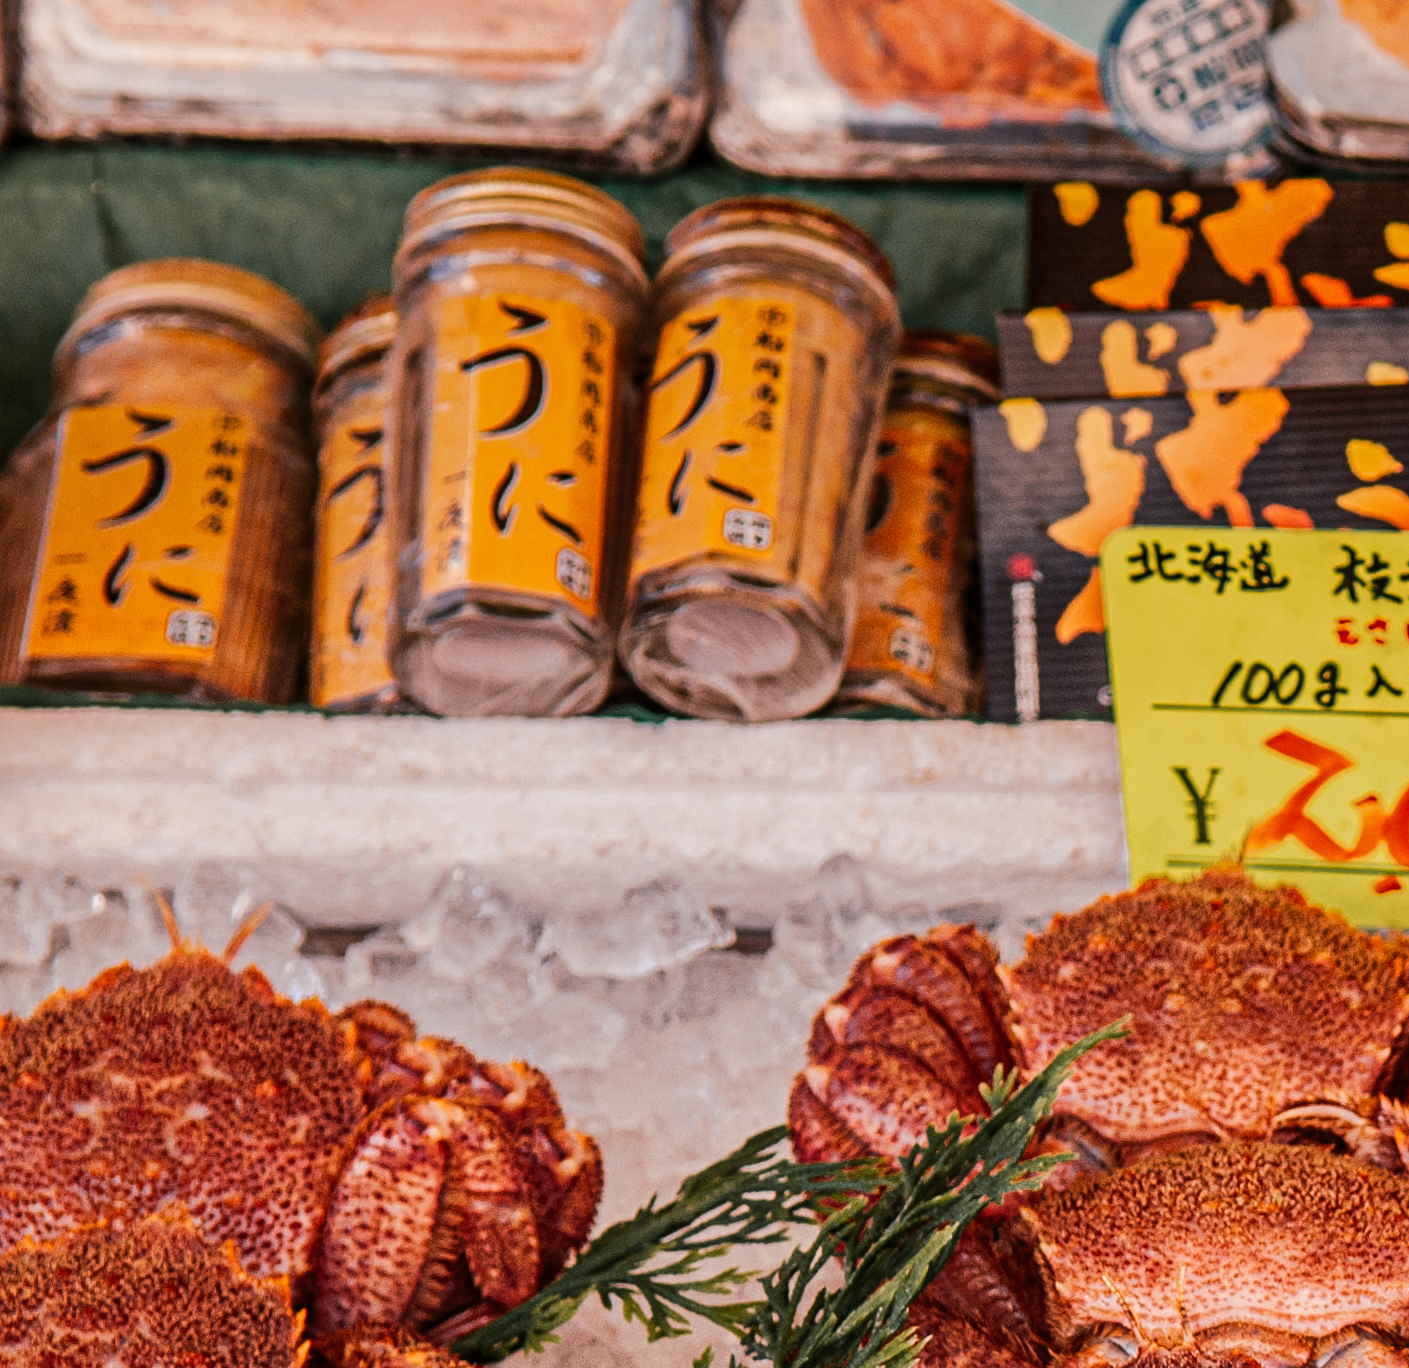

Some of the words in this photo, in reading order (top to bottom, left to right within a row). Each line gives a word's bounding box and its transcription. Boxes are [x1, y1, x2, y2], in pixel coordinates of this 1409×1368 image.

[81, 406, 202, 606] うに
[462, 301, 585, 545] うに
[648, 314, 757, 516] うに
[1127, 540, 1290, 594] 北海道
[1171, 765, 1221, 846] ¥
